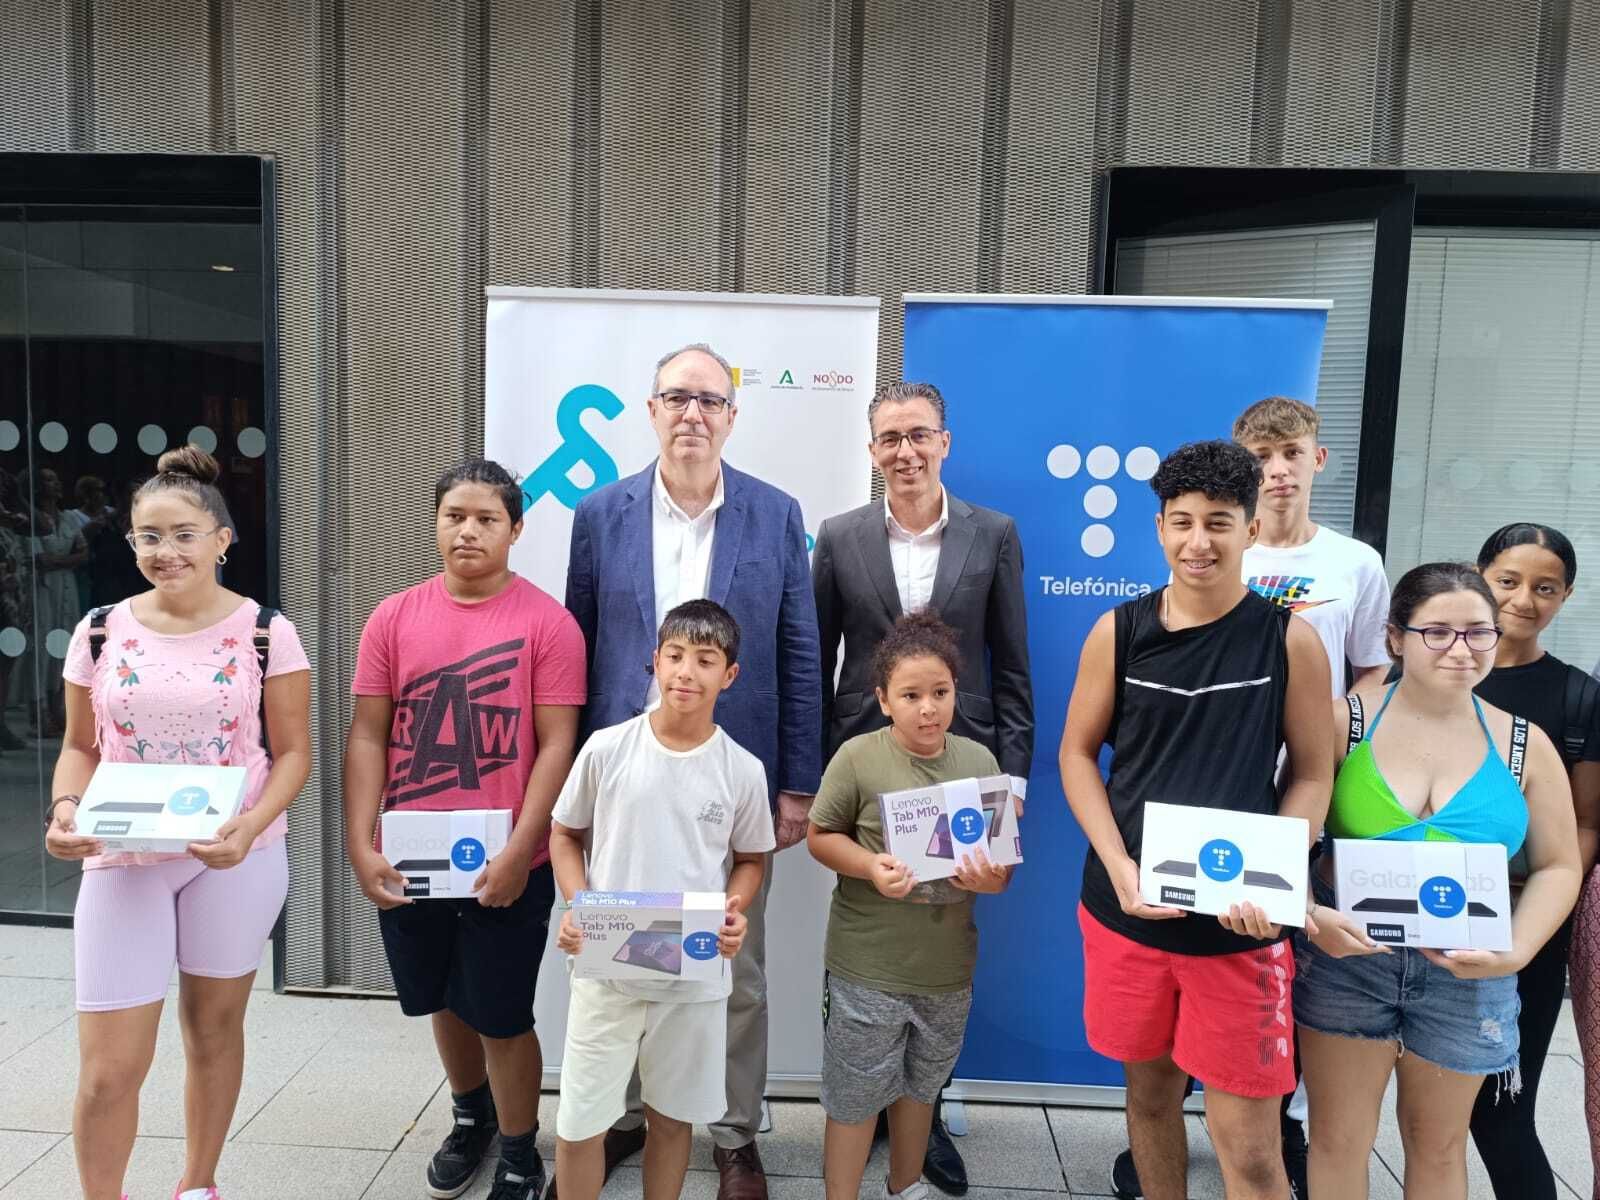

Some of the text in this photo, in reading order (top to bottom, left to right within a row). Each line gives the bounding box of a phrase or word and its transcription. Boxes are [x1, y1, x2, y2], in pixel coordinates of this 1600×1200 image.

[1039, 575, 1152, 597] Telefónica
[1248, 576, 1315, 605] NIKE
[391, 672, 518, 790] RAW
[1514, 726, 1527, 744] LOS
[890, 795, 933, 810] Lenovo
[892, 806, 940, 823] Tab M10
[894, 823, 919, 836] Plus
[580, 911, 628, 921] Lenovo
[580, 922, 635, 931] Tab M10
[1369, 928, 1402, 938] SAMSUNG
[582, 931, 607, 941] Plus
